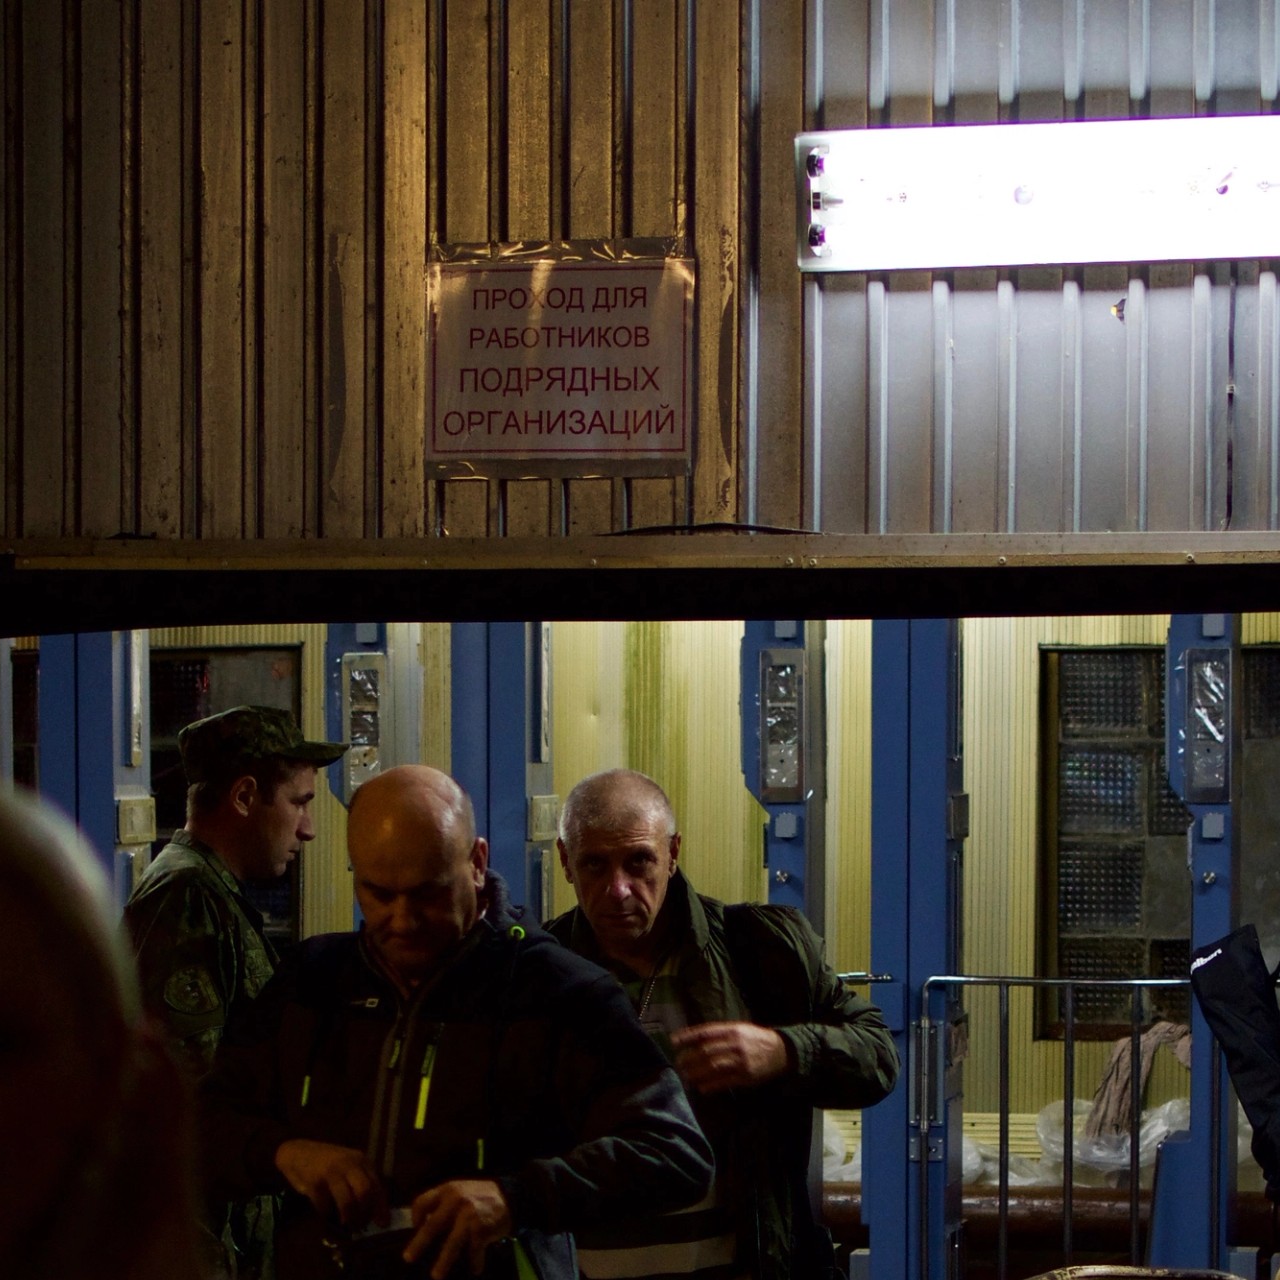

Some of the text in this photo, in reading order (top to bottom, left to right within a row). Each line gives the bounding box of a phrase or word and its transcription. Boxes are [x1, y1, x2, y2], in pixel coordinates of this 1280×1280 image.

[472, 287, 647, 313] ПРОХОД ДЛЯ
[469, 326, 650, 349] РАБОТНИКОВ
[460, 367, 660, 397] ПОДРЯДНЫХ
[443, 404, 675, 440] ОРГАНИЗАЦИЙ
